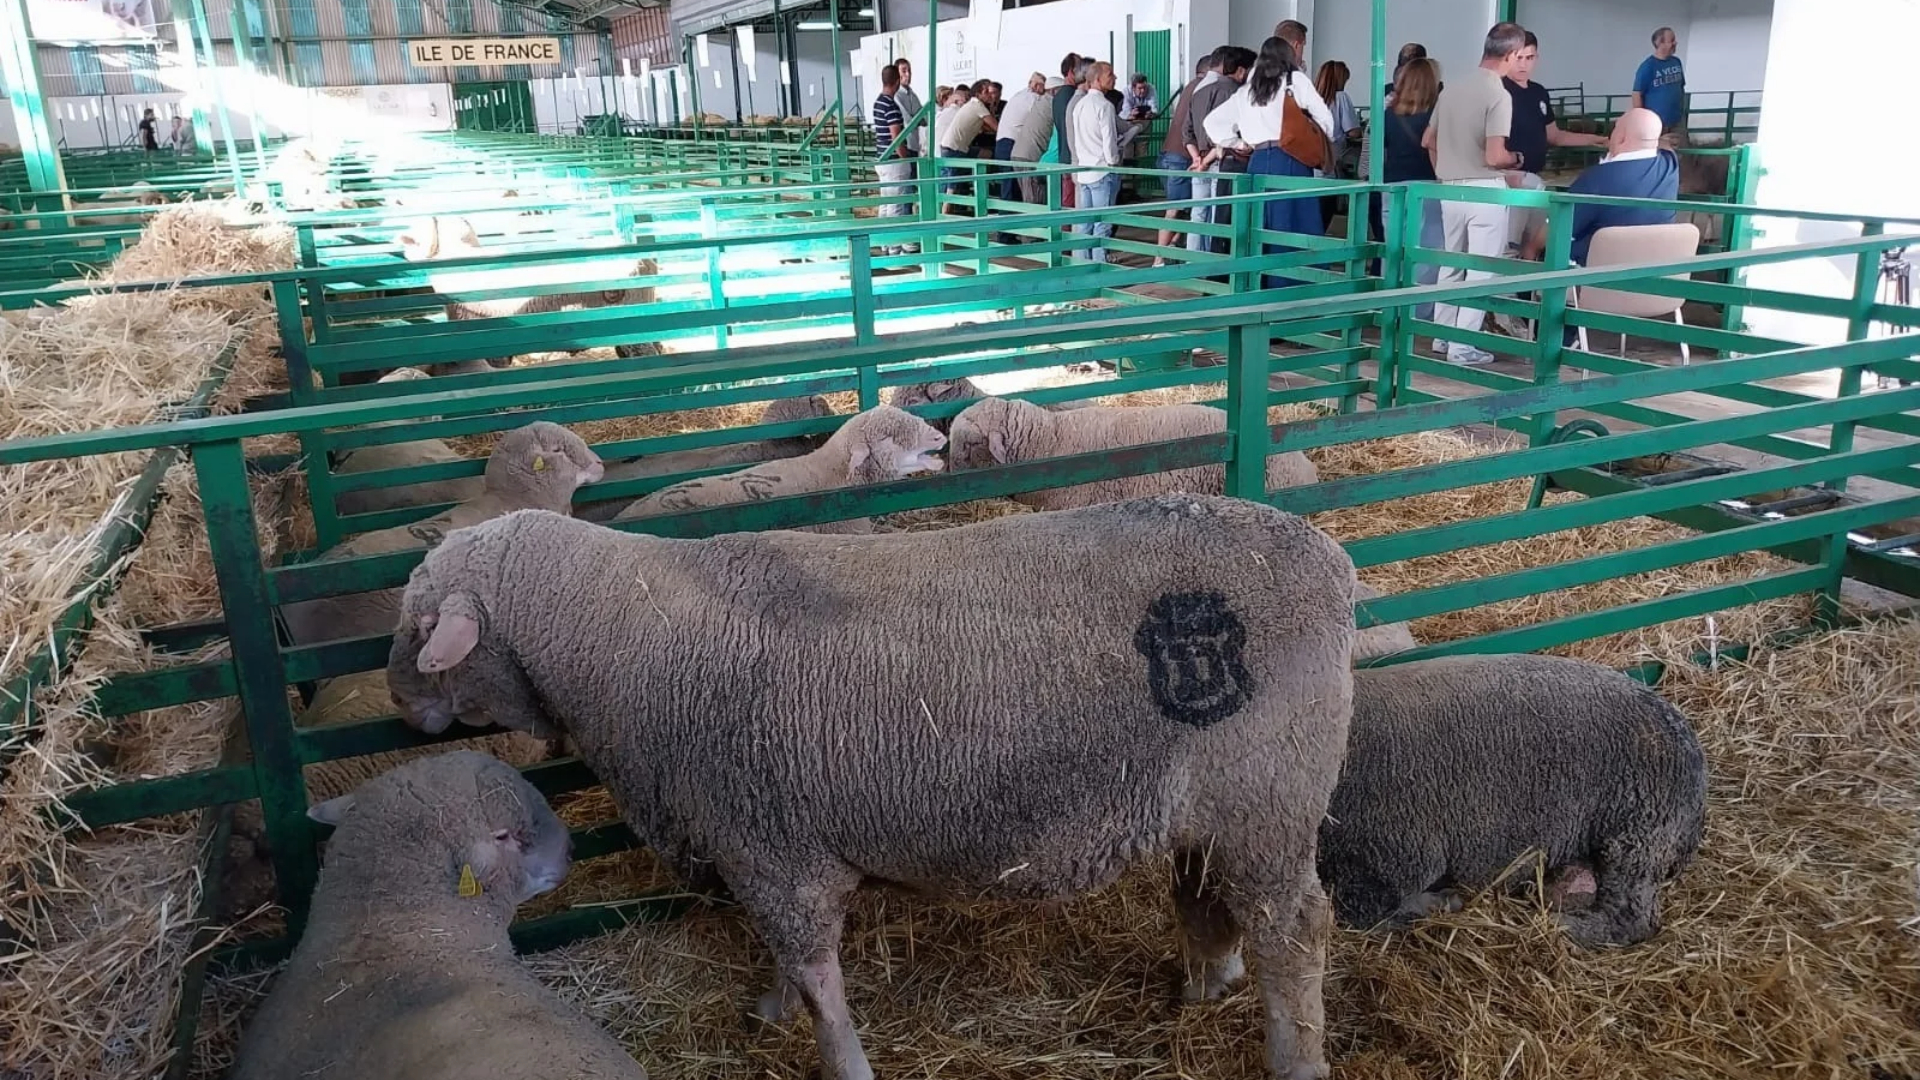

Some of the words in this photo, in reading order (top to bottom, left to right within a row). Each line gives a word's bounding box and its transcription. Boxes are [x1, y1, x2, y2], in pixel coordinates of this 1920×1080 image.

[416, 46, 443, 61] ILE
[451, 45, 475, 60] DE
[484, 43, 554, 59] FRANCE
